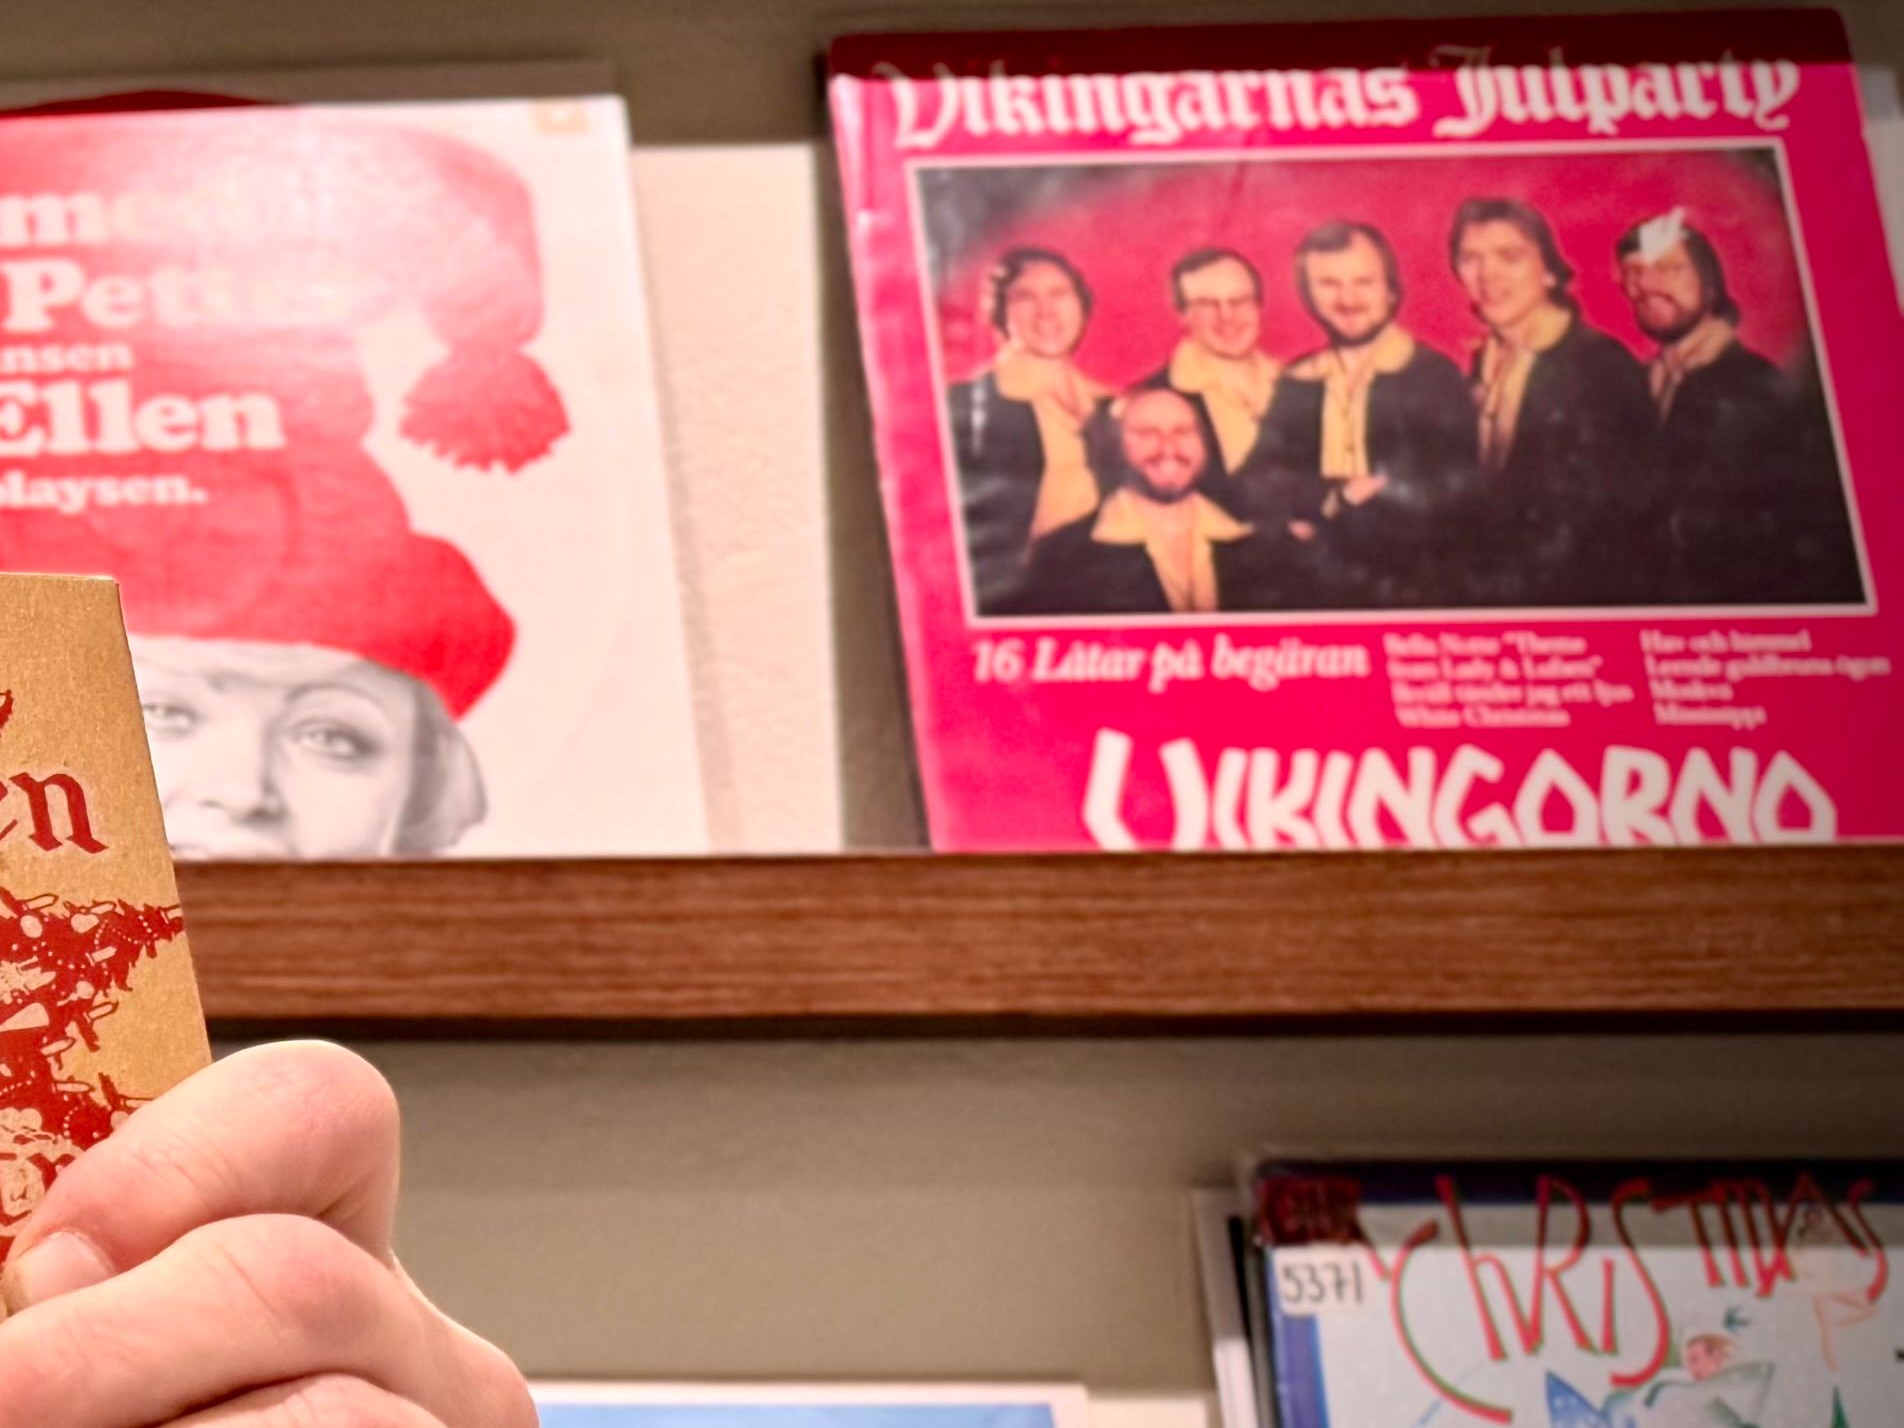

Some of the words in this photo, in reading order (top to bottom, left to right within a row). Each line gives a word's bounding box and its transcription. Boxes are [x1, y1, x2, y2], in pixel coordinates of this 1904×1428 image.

[972, 637, 1026, 684] 16
[1147, 638, 1205, 695] på
[1210, 632, 1372, 693] begäran
[1281, 1260, 1363, 1306] 5371
